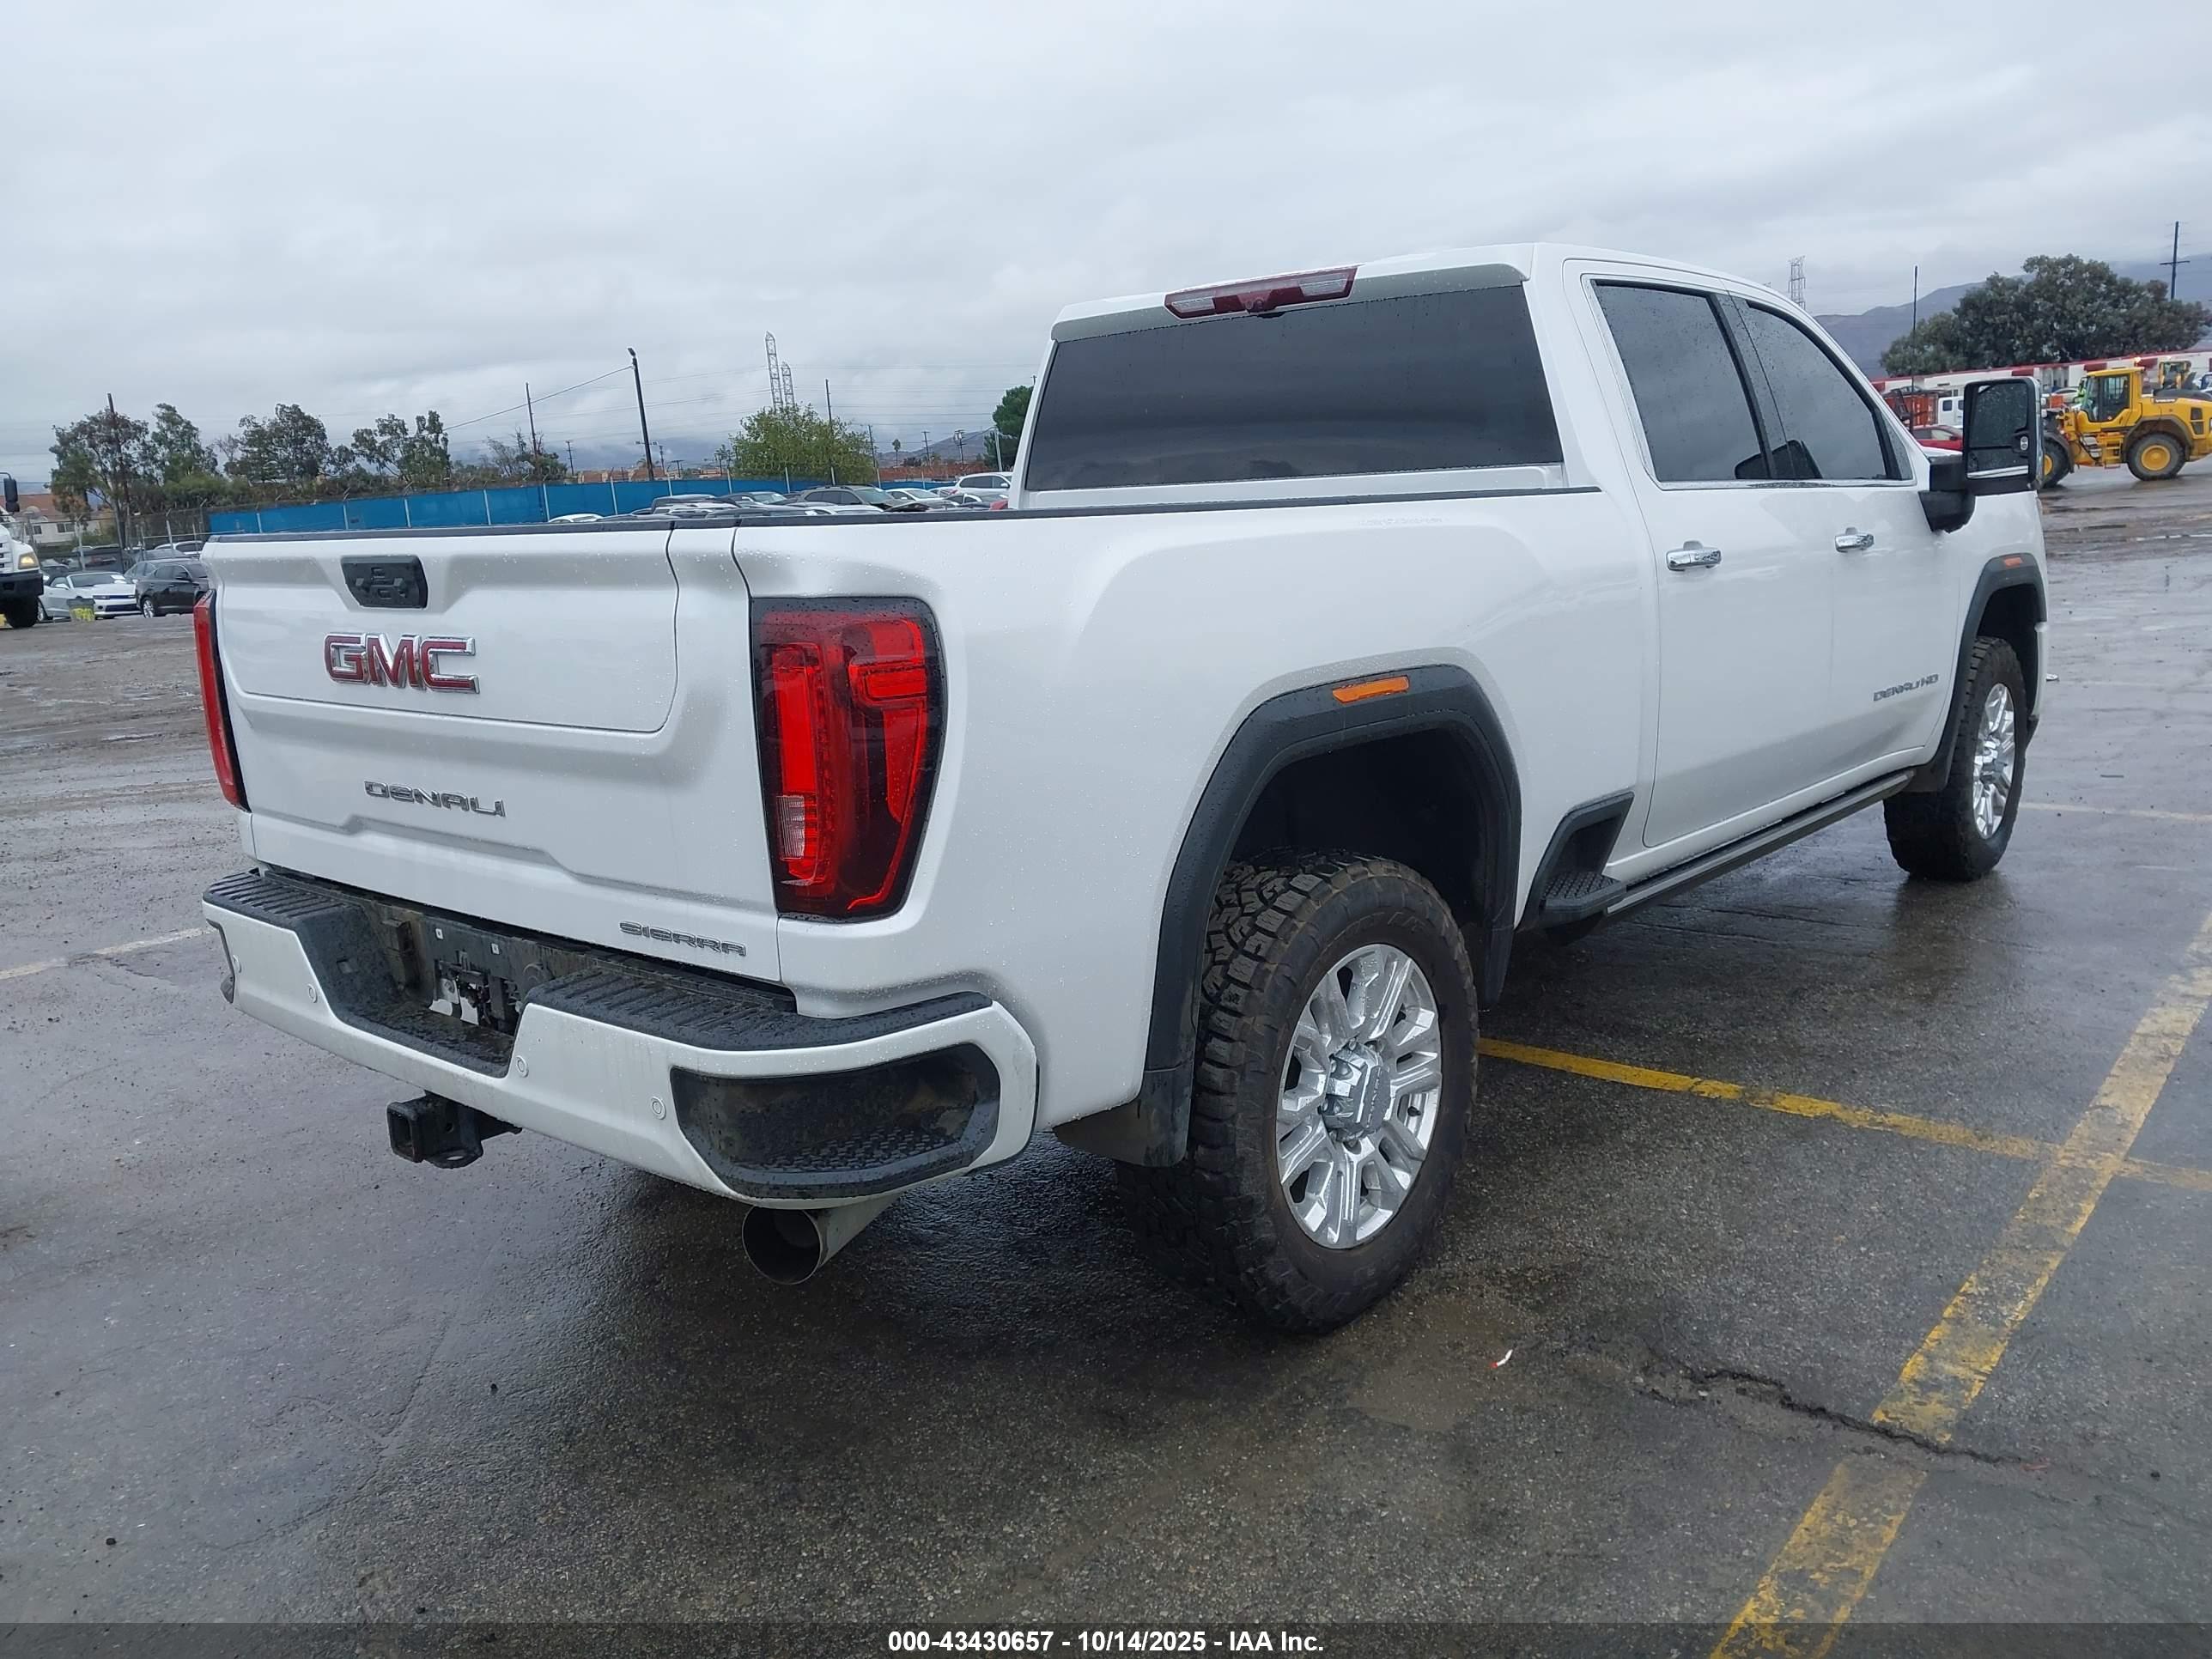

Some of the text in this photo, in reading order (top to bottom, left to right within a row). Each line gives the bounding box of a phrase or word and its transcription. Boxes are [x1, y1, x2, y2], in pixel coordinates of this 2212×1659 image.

[324, 632, 481, 695] GMC
[1873, 680, 1920, 702] DENALI
[363, 779, 506, 817] DENALI
[618, 920, 747, 957] SIERRA
